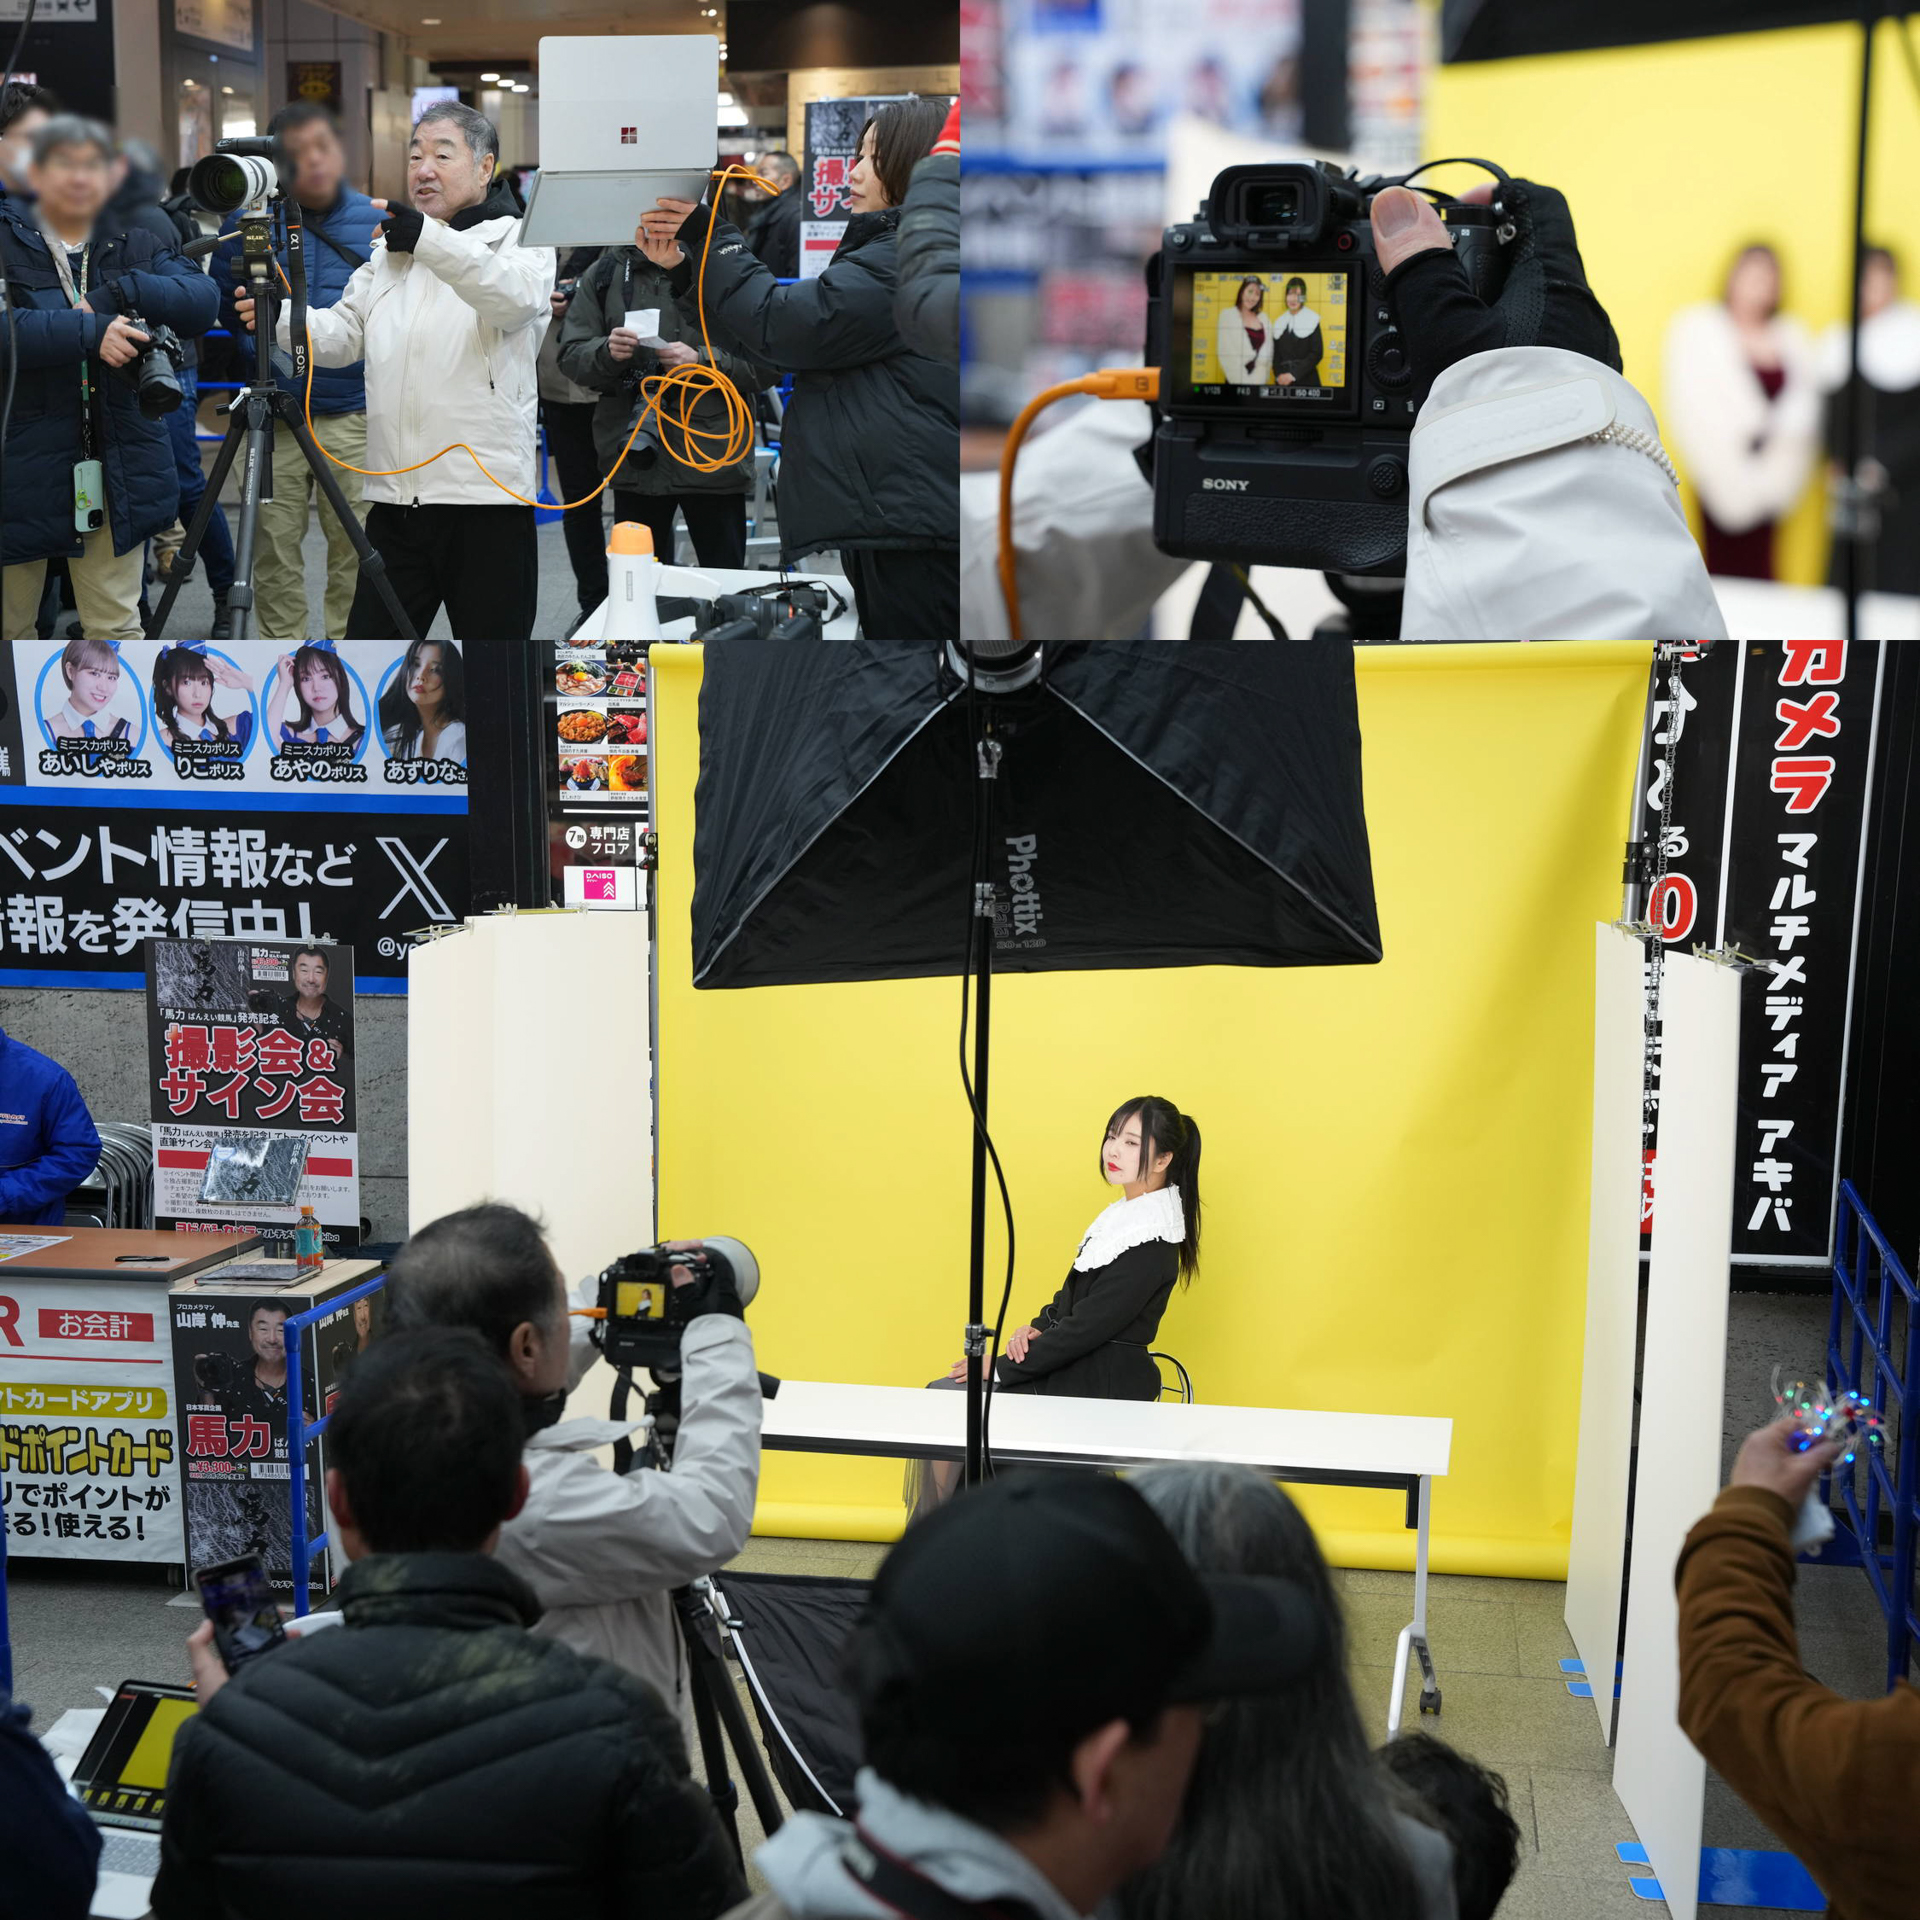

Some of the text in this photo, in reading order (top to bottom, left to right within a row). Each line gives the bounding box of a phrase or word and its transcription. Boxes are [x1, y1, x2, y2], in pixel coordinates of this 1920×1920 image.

[1378, 310, 1389, 320] Fn
[1295, 388, 1307, 397] ISO
[1202, 478, 1249, 491] SONY
[59, 739, 129, 752] ミニスカポリス
[174, 742, 240, 755] ミニスカポリス
[284, 744, 352, 757] ミニスカポリス
[176, 756, 242, 777] りこポリス
[273, 758, 365, 780] あやのポリス
[590, 826, 630, 841] 専門店
[591, 843, 630, 855] フロア
[1005, 834, 1044, 936] Phottix
[1761, 833, 1818, 1098] マルチメディア
[159, 1070, 346, 1124] サイン会
[1747, 1119, 1796, 1232] アキバ
[176, 1303, 215, 1311] プロカメラマン
[59, 1313, 133, 1339] お会計
[176, 1312, 207, 1329] 山岸
[0, 1387, 153, 1414] トカードアプリ
[185, 1413, 271, 1459] 馬力
